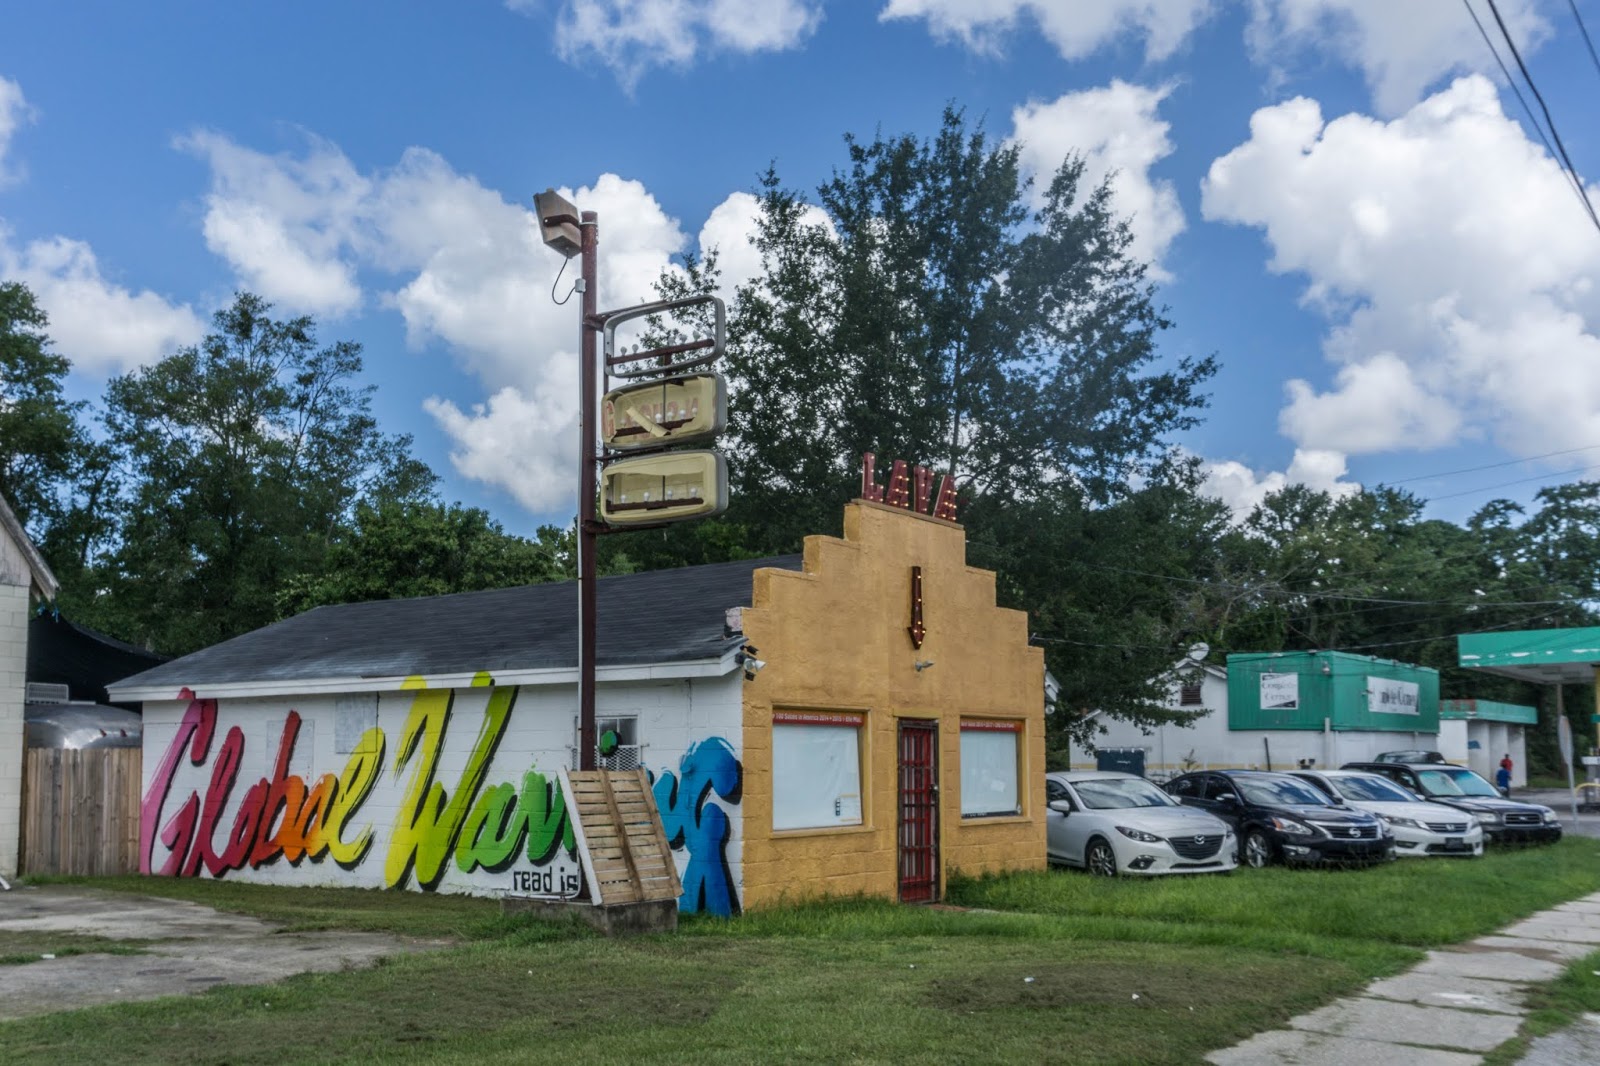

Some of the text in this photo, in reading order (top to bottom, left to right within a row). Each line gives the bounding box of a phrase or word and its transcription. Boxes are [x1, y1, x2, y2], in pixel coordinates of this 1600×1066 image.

[861, 452, 957, 523] LAVA
[139, 686, 386, 879] Global
[513, 865, 579, 893] read is
